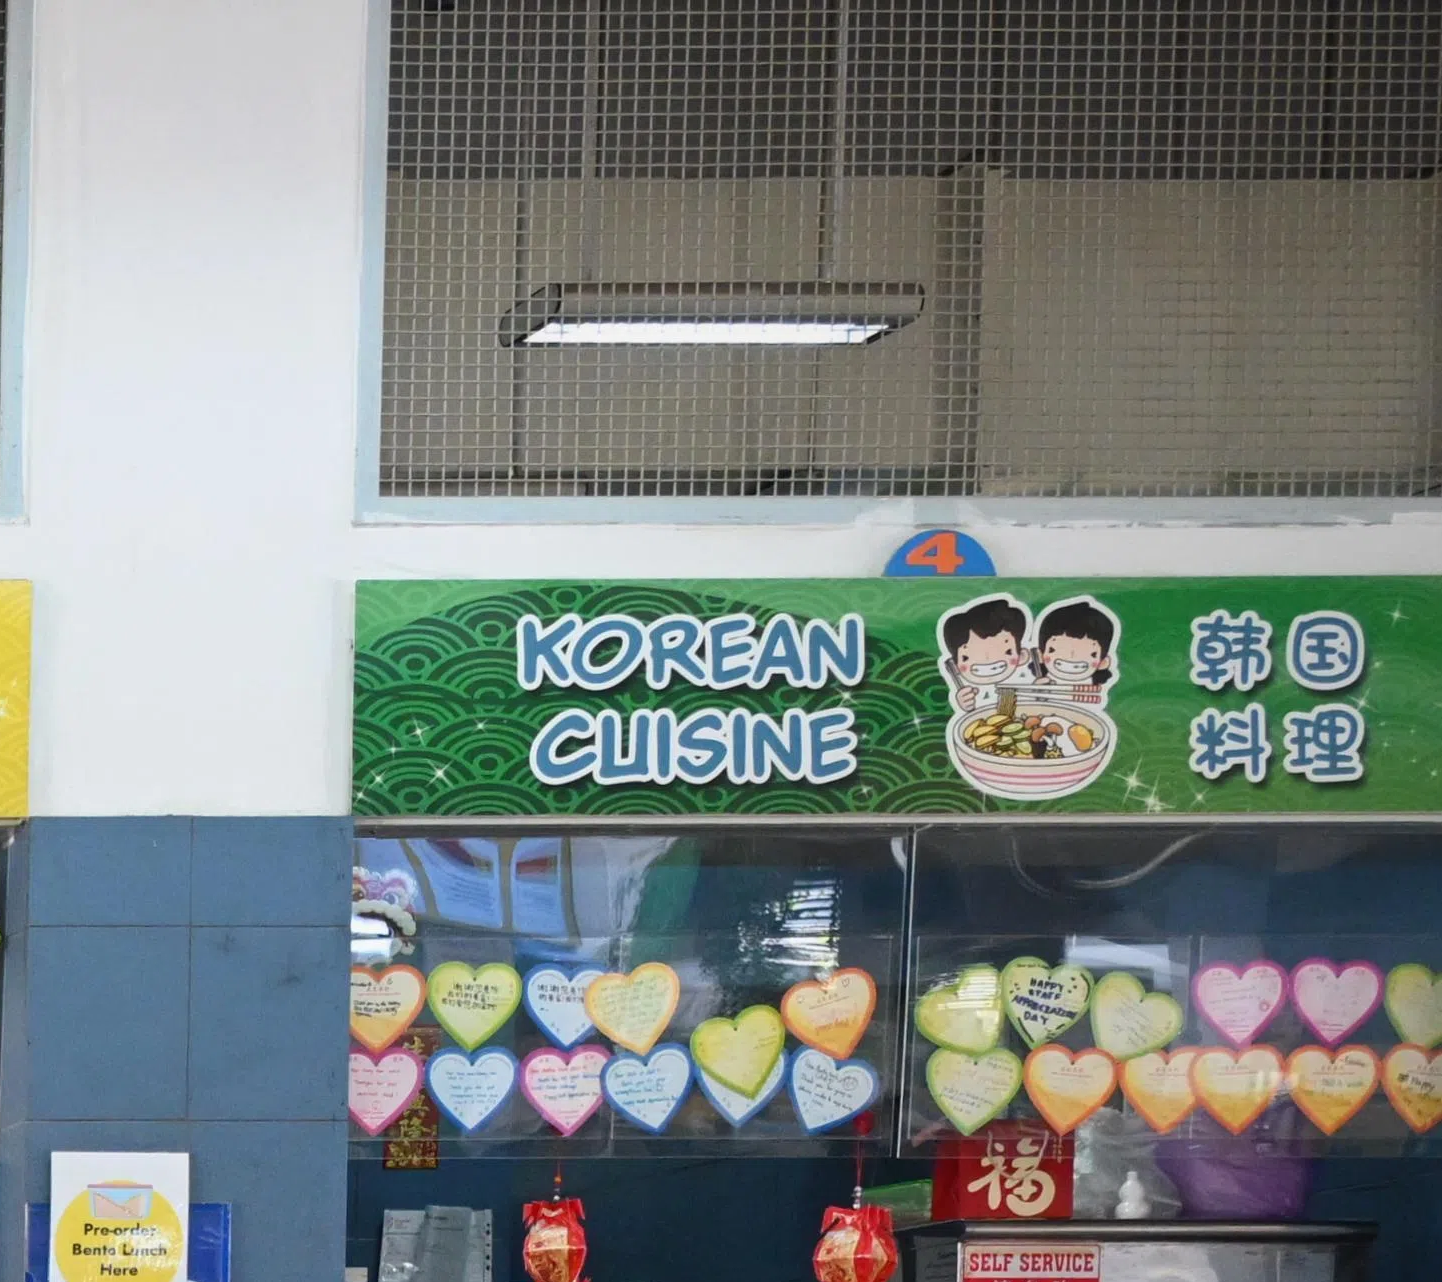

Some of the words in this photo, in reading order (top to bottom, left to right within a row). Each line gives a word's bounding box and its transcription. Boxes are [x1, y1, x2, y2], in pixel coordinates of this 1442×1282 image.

[906, 535, 964, 573] 4
[518, 612, 865, 692] KOREAN
[1190, 610, 1365, 691] 韩国
[530, 708, 858, 787] CUISINE
[1190, 703, 1365, 783] 料理
[1030, 977, 1064, 993] HAPPY
[1024, 1010, 1049, 1025] DAY
[967, 1134, 1056, 1217] 福
[83, 1222, 157, 1238] Pre-order
[72, 1243, 116, 1257] Bento
[123, 1242, 168, 1257] Lunch
[969, 1254, 1014, 1273] SELF
[1020, 1253, 1095, 1273] SERVICE
[100, 1263, 139, 1278] Here
